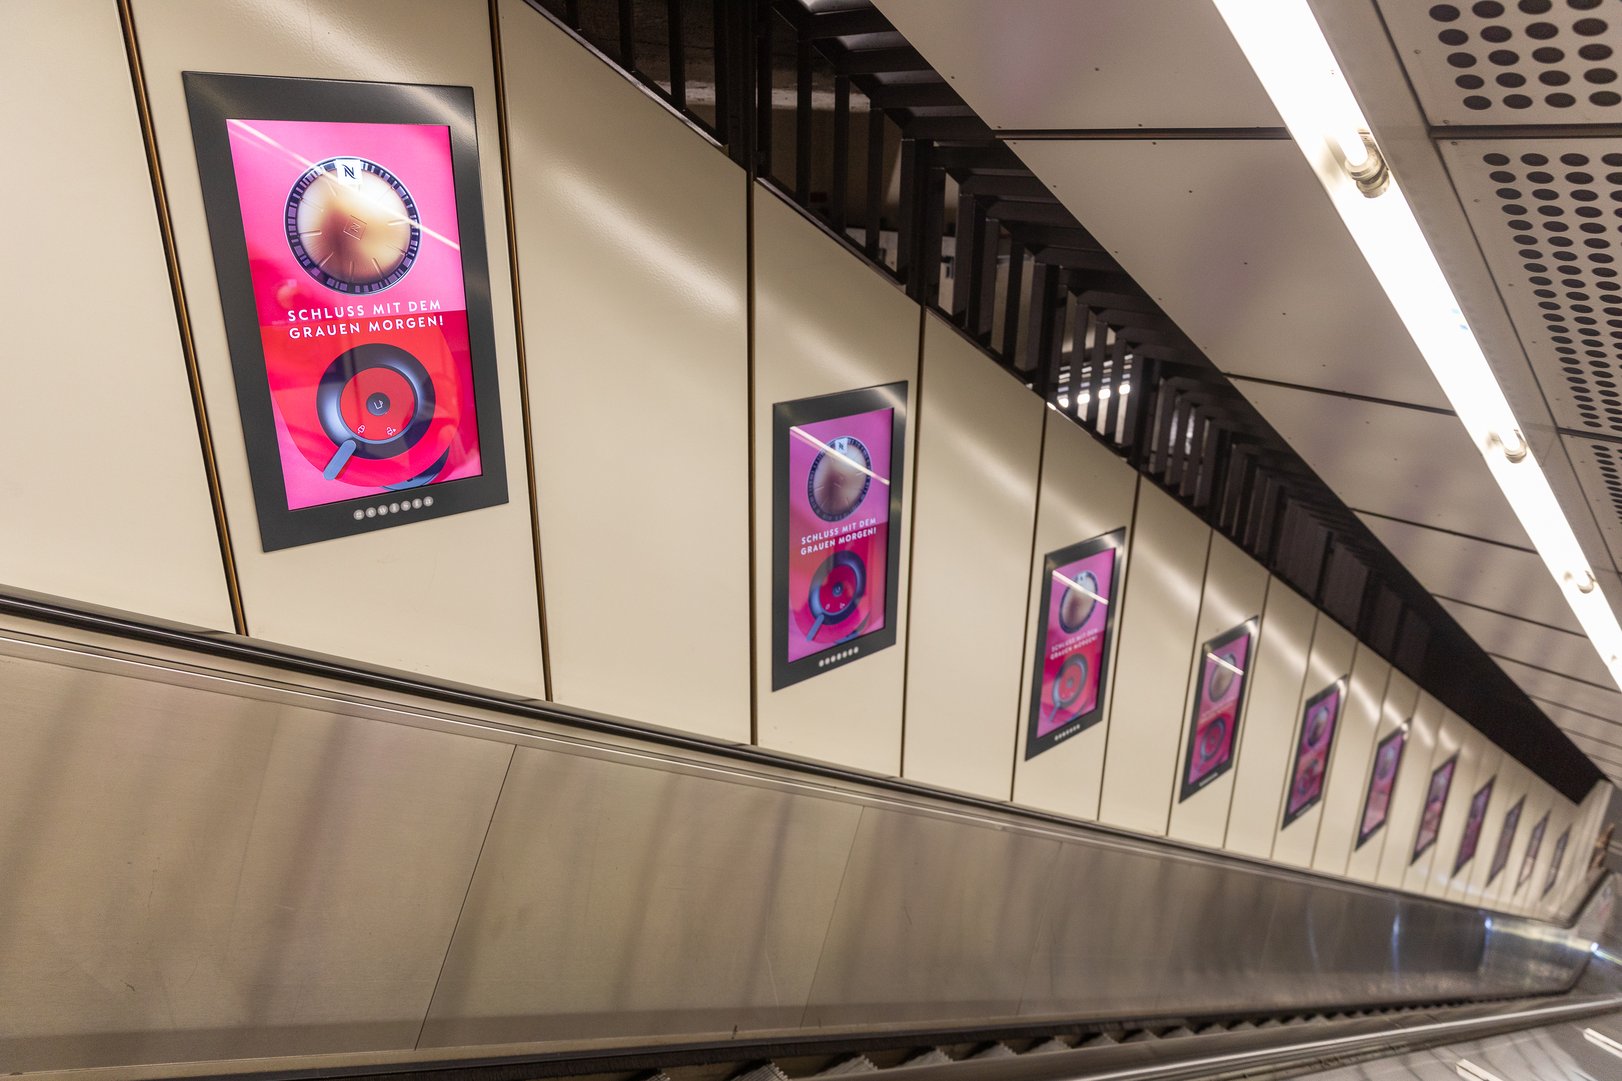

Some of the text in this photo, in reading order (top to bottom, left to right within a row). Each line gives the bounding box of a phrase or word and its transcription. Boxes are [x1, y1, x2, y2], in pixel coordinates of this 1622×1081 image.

[287, 299, 441, 322] SCHLUSS MIT DEM
[289, 315, 444, 340] GRAUEN MORGEN!
[800, 526, 877, 556] GRAUEN MORGEN!
[801, 517, 877, 545] SCHLUSS MIT DEM
